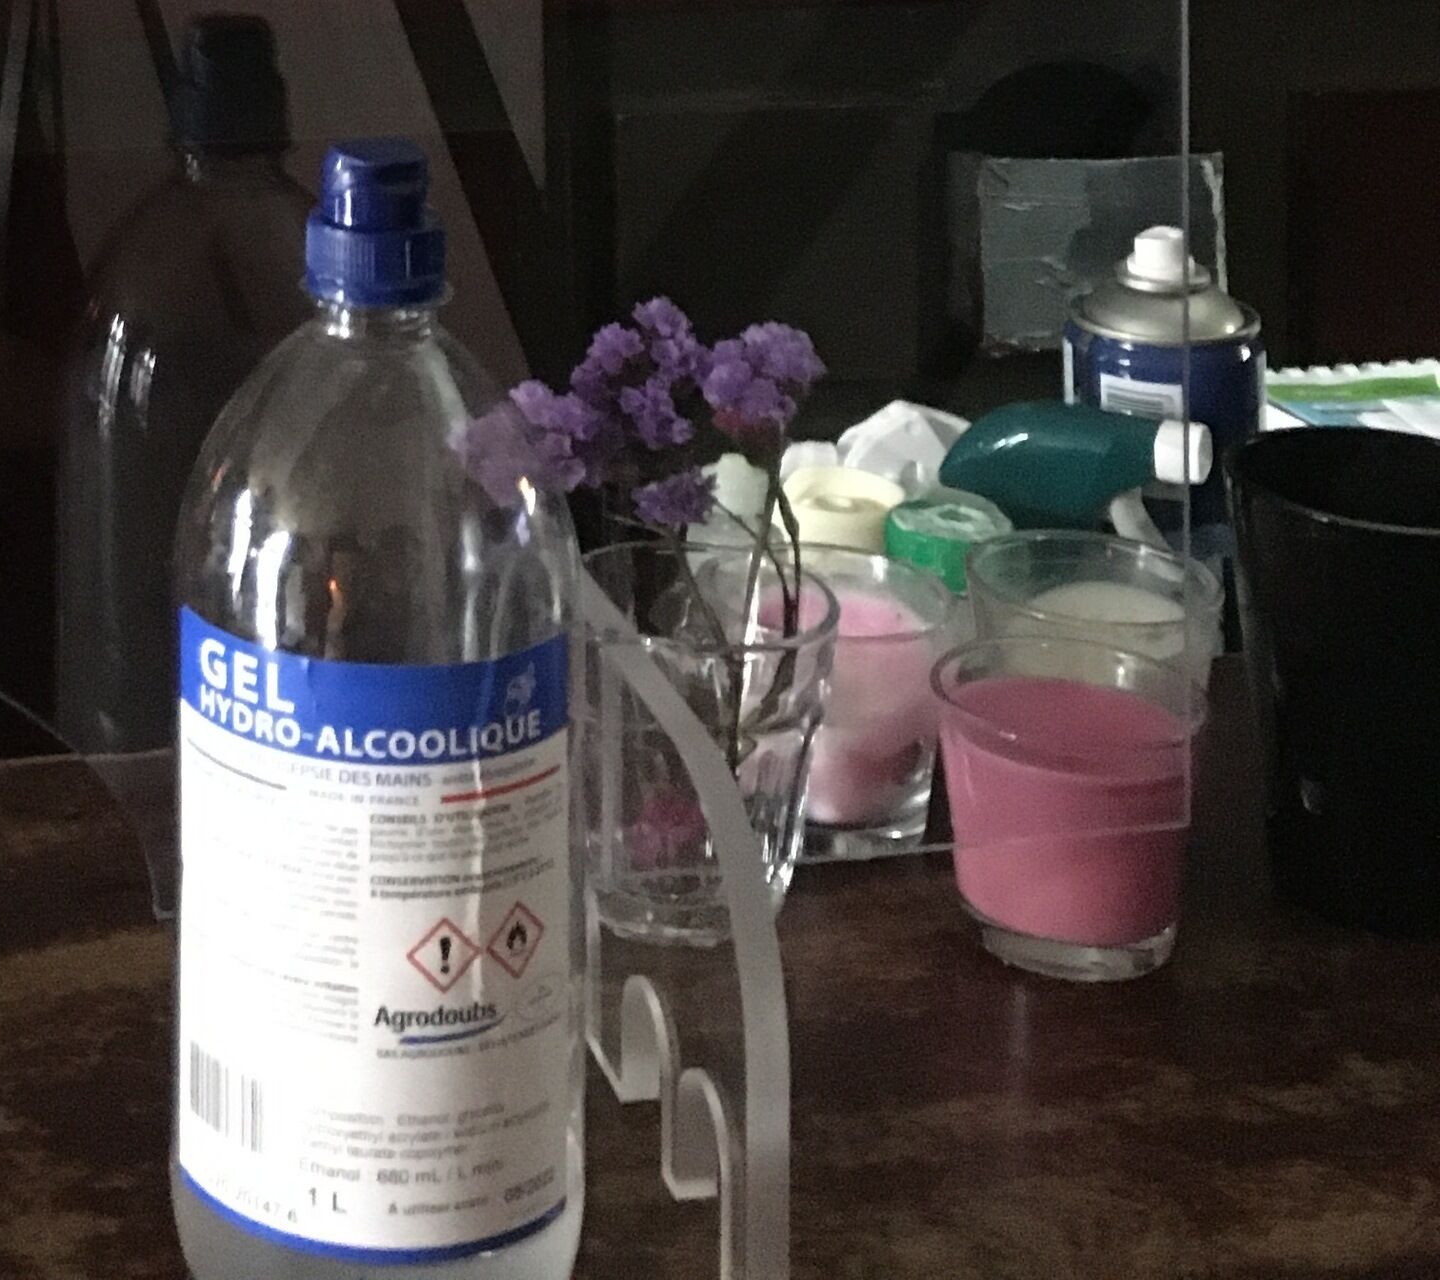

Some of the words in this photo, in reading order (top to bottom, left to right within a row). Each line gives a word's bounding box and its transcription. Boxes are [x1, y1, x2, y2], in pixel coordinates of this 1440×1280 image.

[198, 636, 296, 715] GEL
[199, 683, 543, 761] HYDRO-ALCOOLIQUE
[338, 768, 371, 788] DES
[375, 770, 433, 789] MAINS
[369, 794, 421, 808] FRANCE
[374, 1000, 498, 1033] Agrodoubs
[331, 1191, 348, 1214] L
